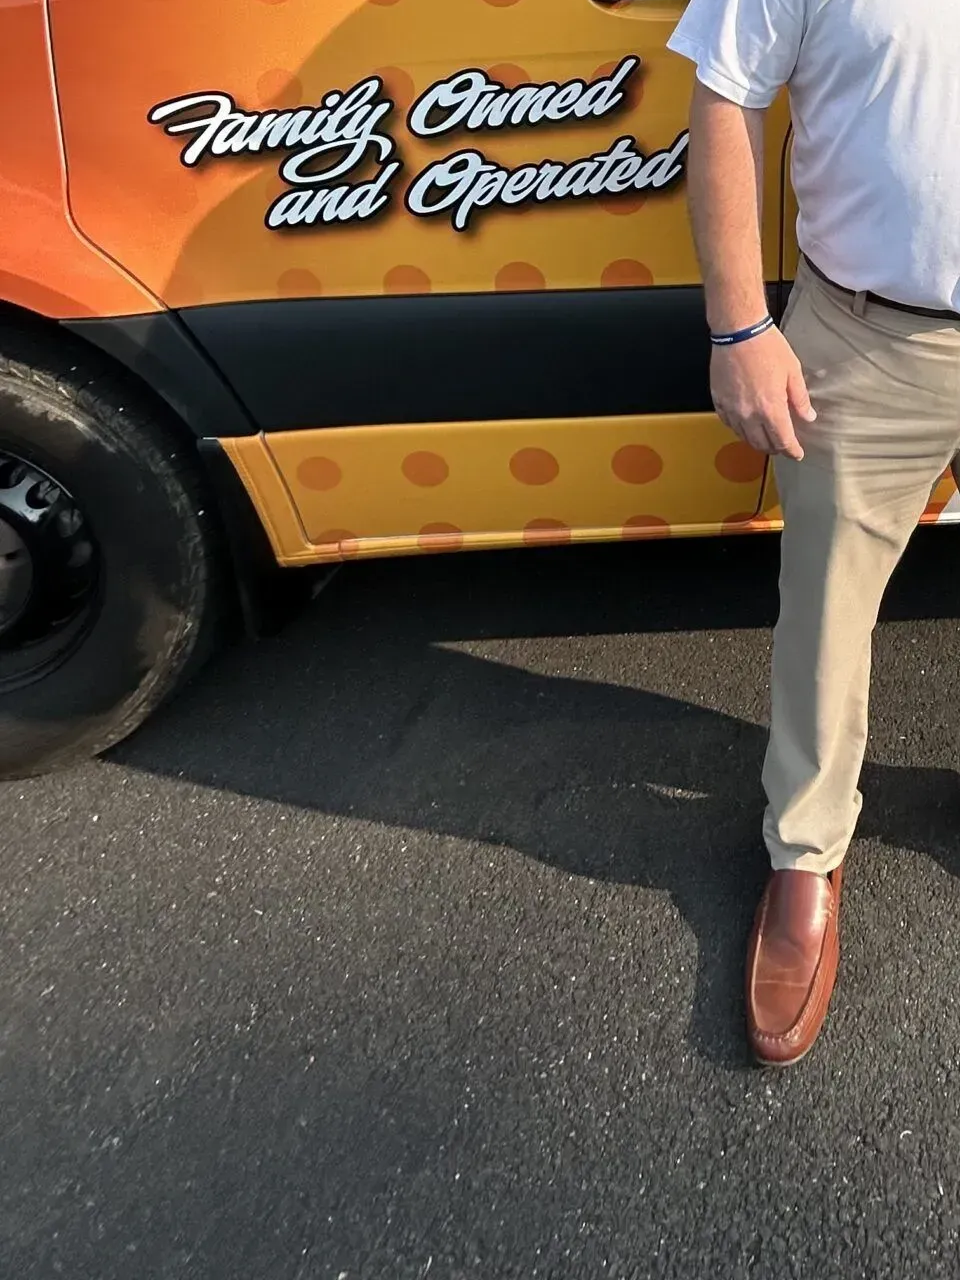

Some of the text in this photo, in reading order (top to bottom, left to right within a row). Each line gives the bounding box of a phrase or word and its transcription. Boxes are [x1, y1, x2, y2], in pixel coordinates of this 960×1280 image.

[151, 58, 638, 184] Family Owned
[267, 132, 690, 229] and Operated
